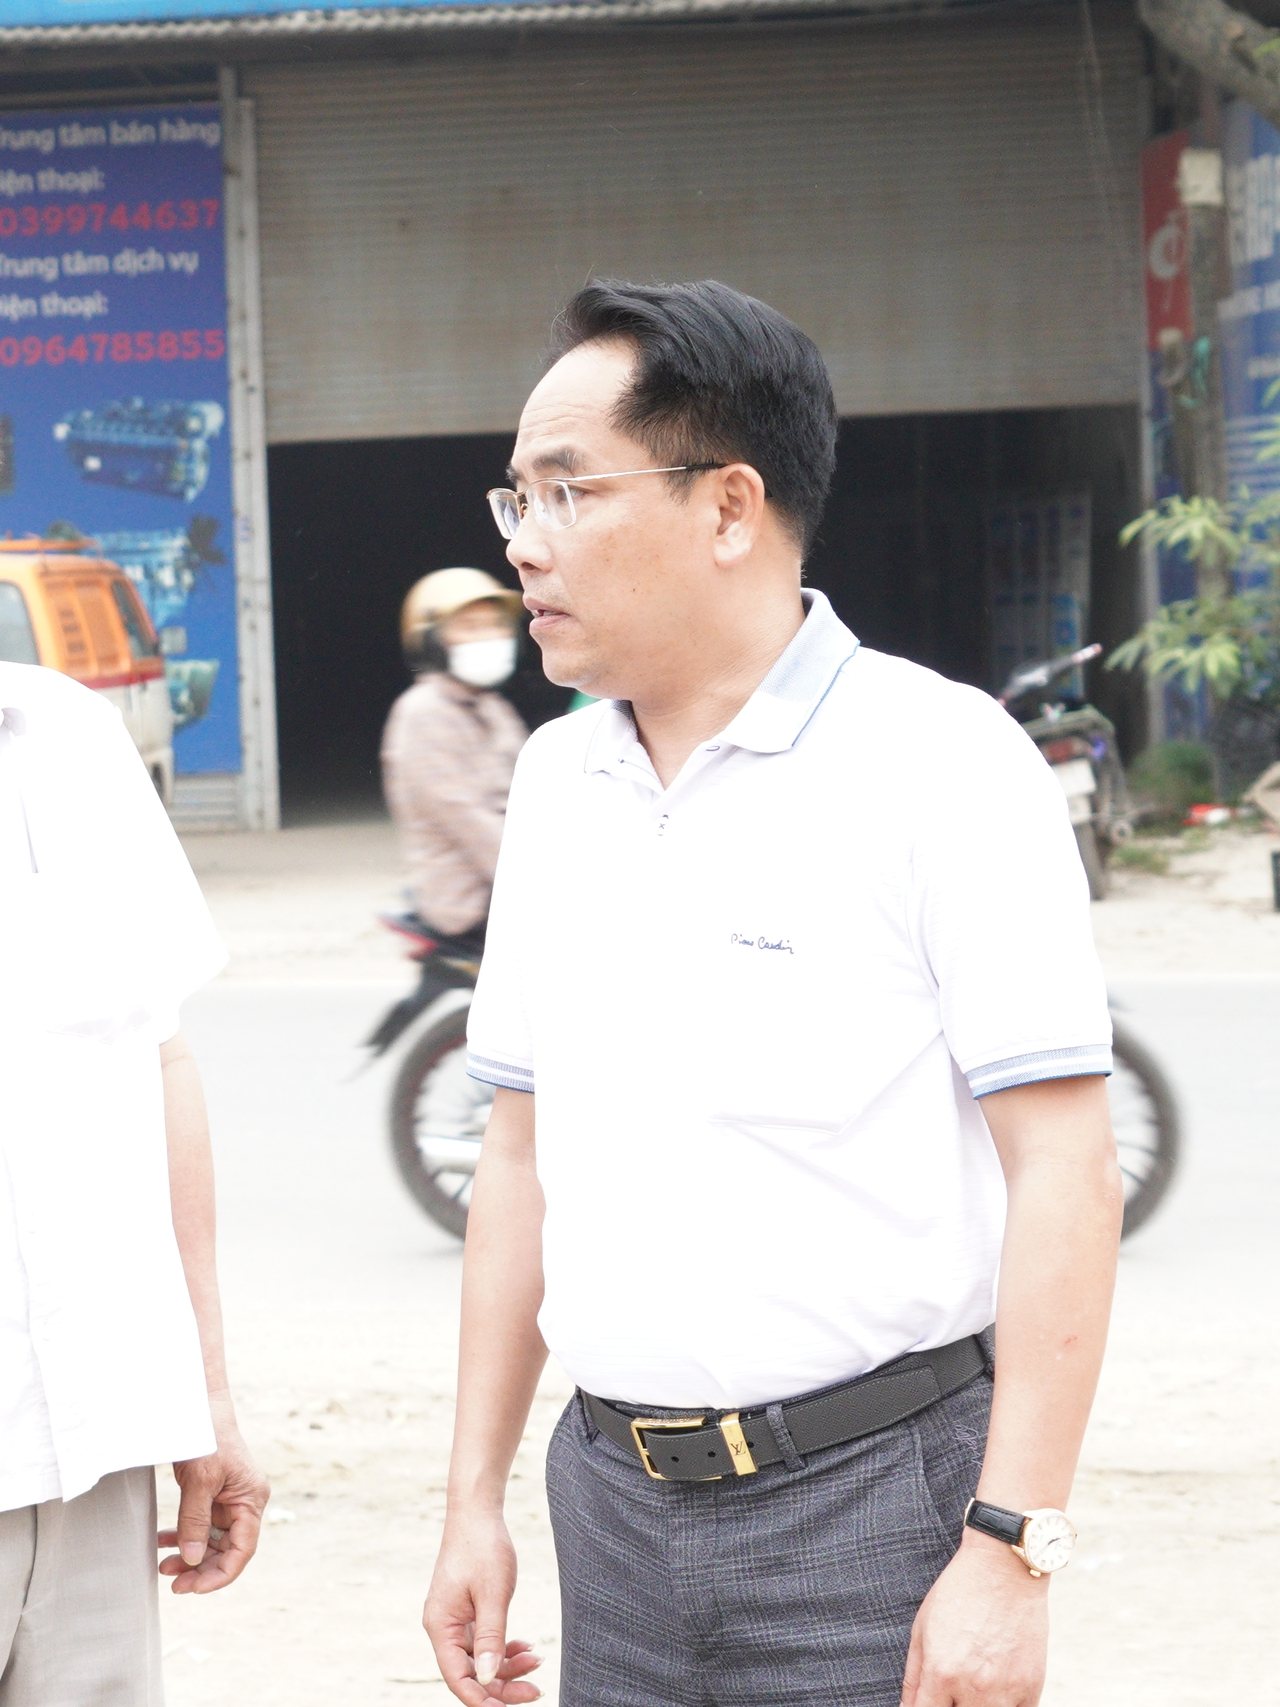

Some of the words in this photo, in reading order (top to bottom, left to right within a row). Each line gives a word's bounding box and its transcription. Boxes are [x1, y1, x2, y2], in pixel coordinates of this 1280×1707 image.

[59, 123, 106, 147] tâm
[110, 121, 156, 145] bán
[159, 117, 220, 147] hàng
[62, 251, 109, 276] tâm
[113, 248, 165, 277] dịch
[169, 251, 199, 275] vụ
